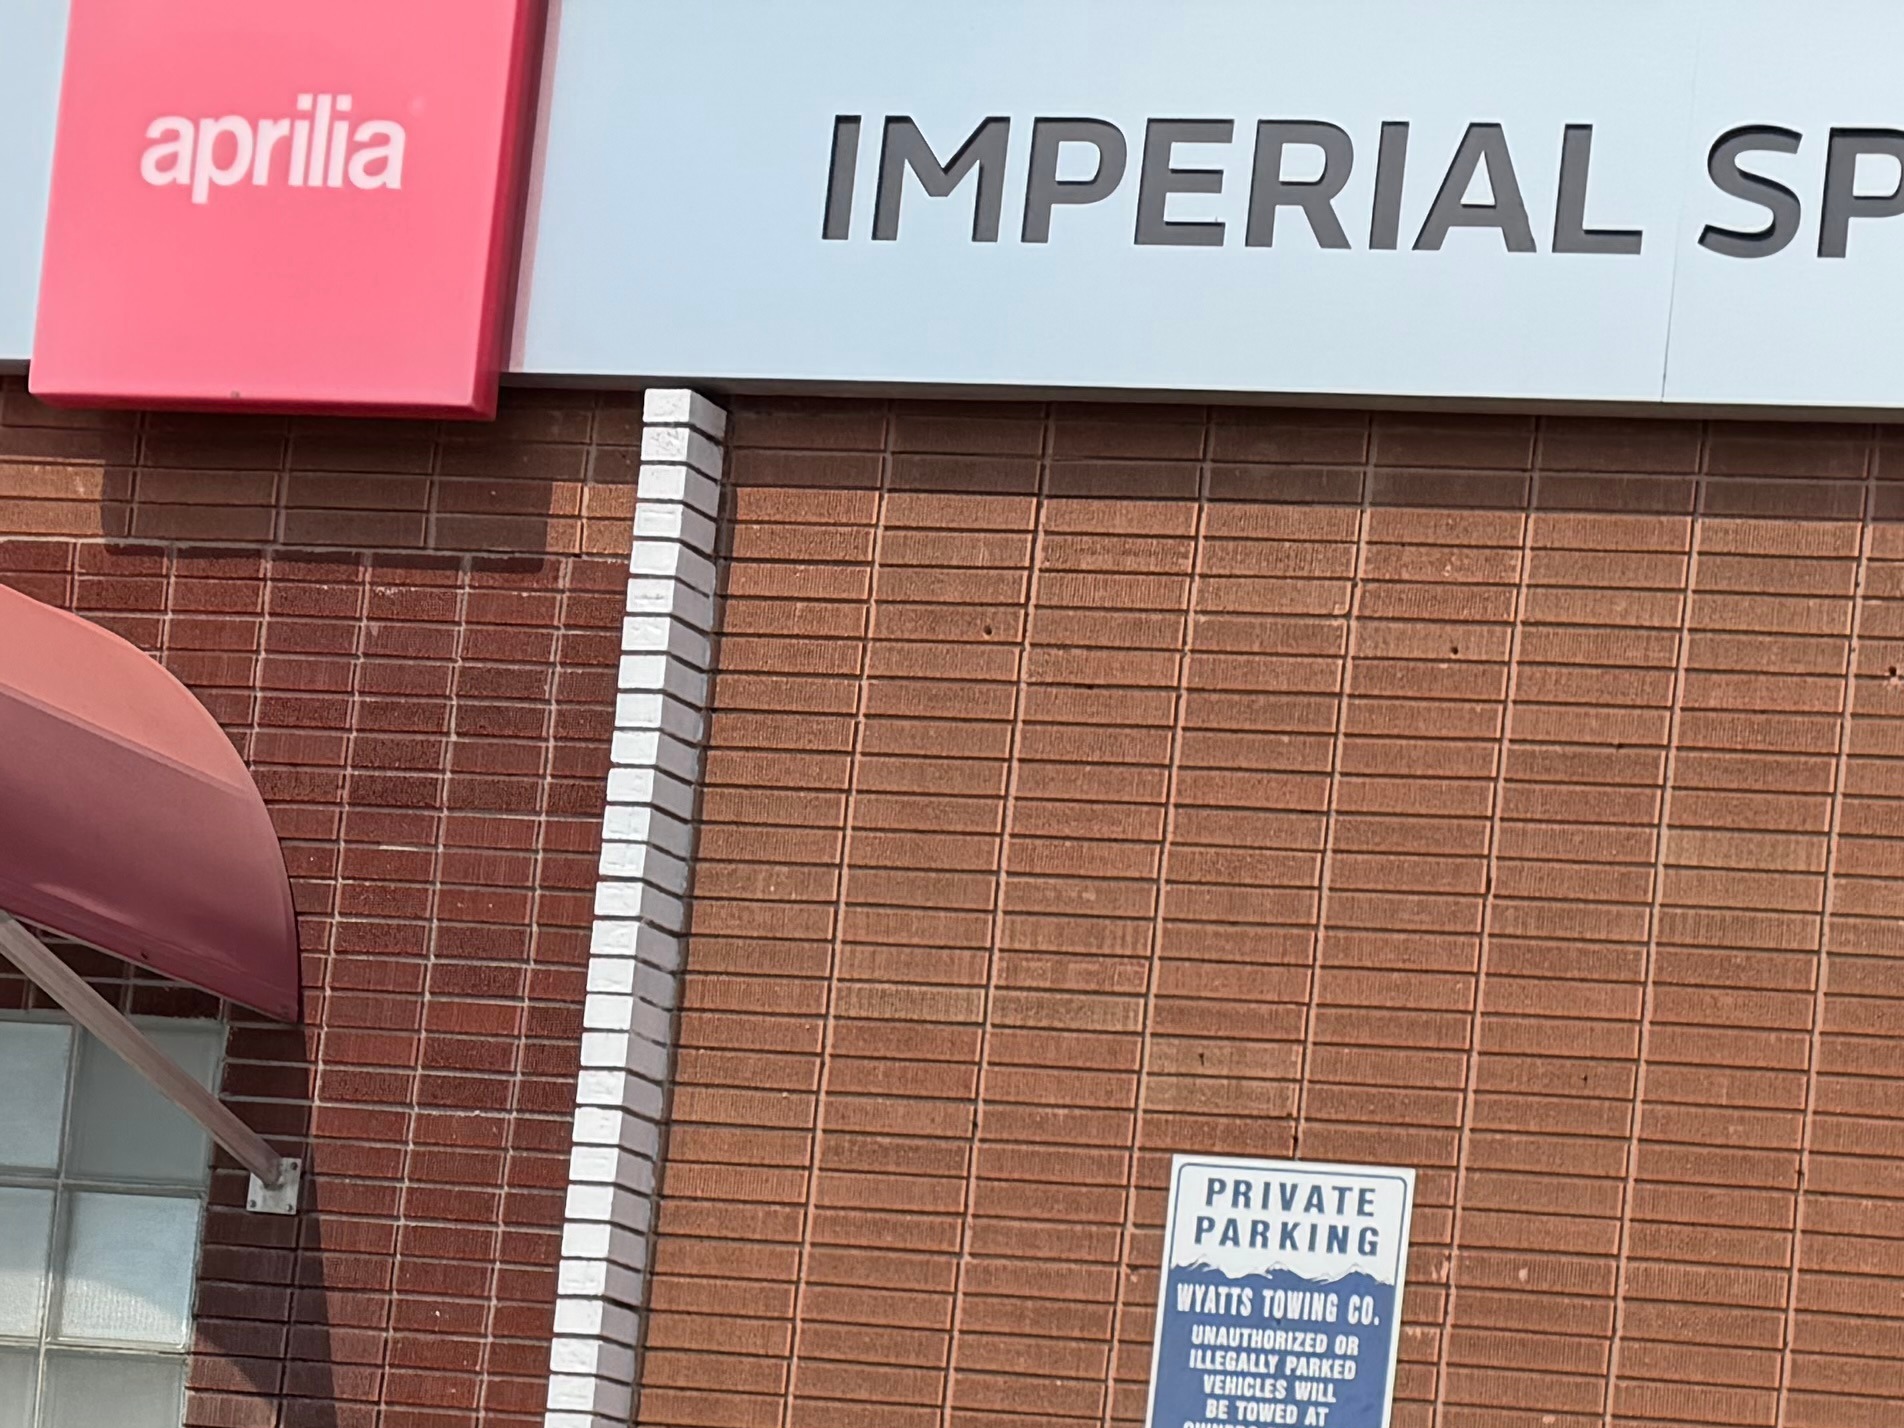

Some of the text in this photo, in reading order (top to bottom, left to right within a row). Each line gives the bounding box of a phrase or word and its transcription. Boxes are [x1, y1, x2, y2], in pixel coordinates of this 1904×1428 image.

[140, 93, 406, 204] aprilia
[822, 115, 1642, 254] IMPERIAL
[1205, 1178, 1376, 1217] PRIVATE
[1194, 1216, 1380, 1256] PARKING
[1177, 1283, 1380, 1326] WYATTS TOWING CO.
[1192, 1325, 1359, 1356] UNAUTHORIZED OR
[1189, 1349, 1356, 1380] ILLEGALLY PARKED
[1204, 1375, 1336, 1403] VEHICLES WILL
[1206, 1399, 1328, 1426] BE TOWED AT
